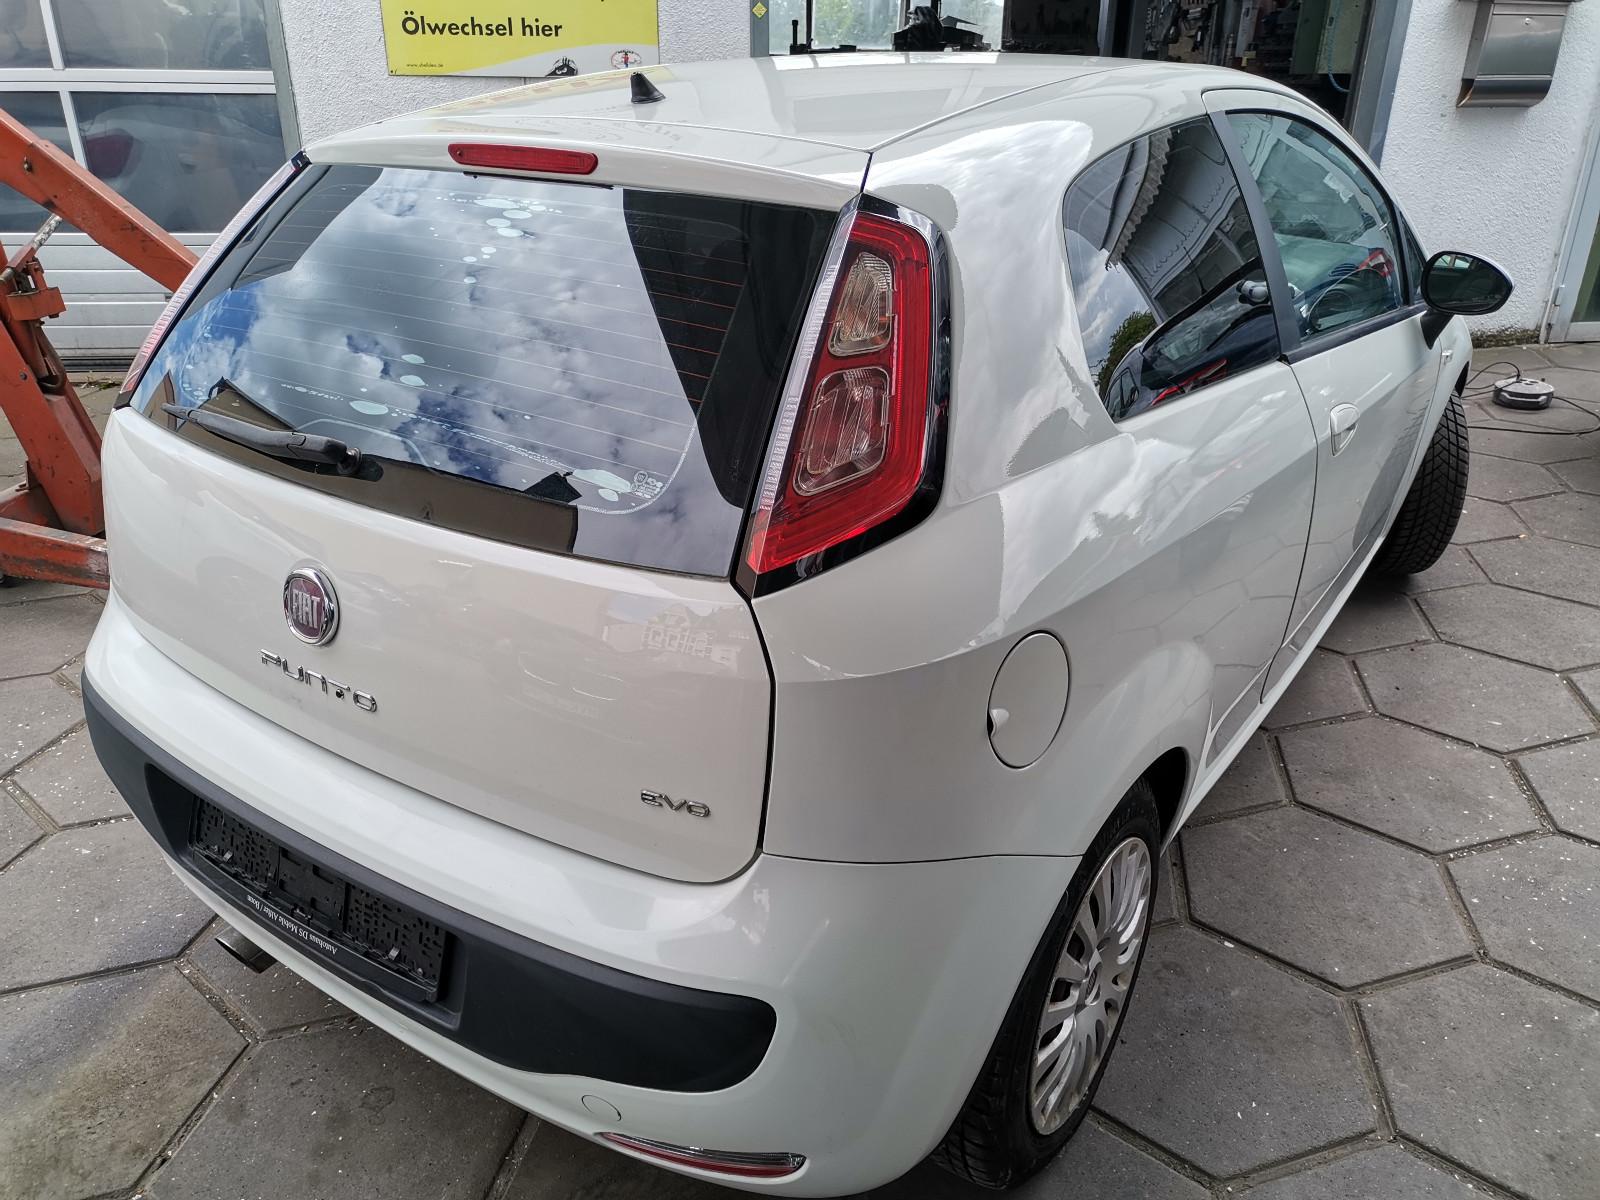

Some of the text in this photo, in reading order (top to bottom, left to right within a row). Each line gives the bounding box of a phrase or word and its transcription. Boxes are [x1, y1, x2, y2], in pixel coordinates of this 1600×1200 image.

[401, 10, 563, 38] Ölwechsel hier
[292, 588, 321, 629] FIAT
[640, 789, 711, 818] EVO
[278, 916, 298, 934] Mobile
[298, 928, 309, 940] DS
[309, 933, 338, 955] Autohaus
